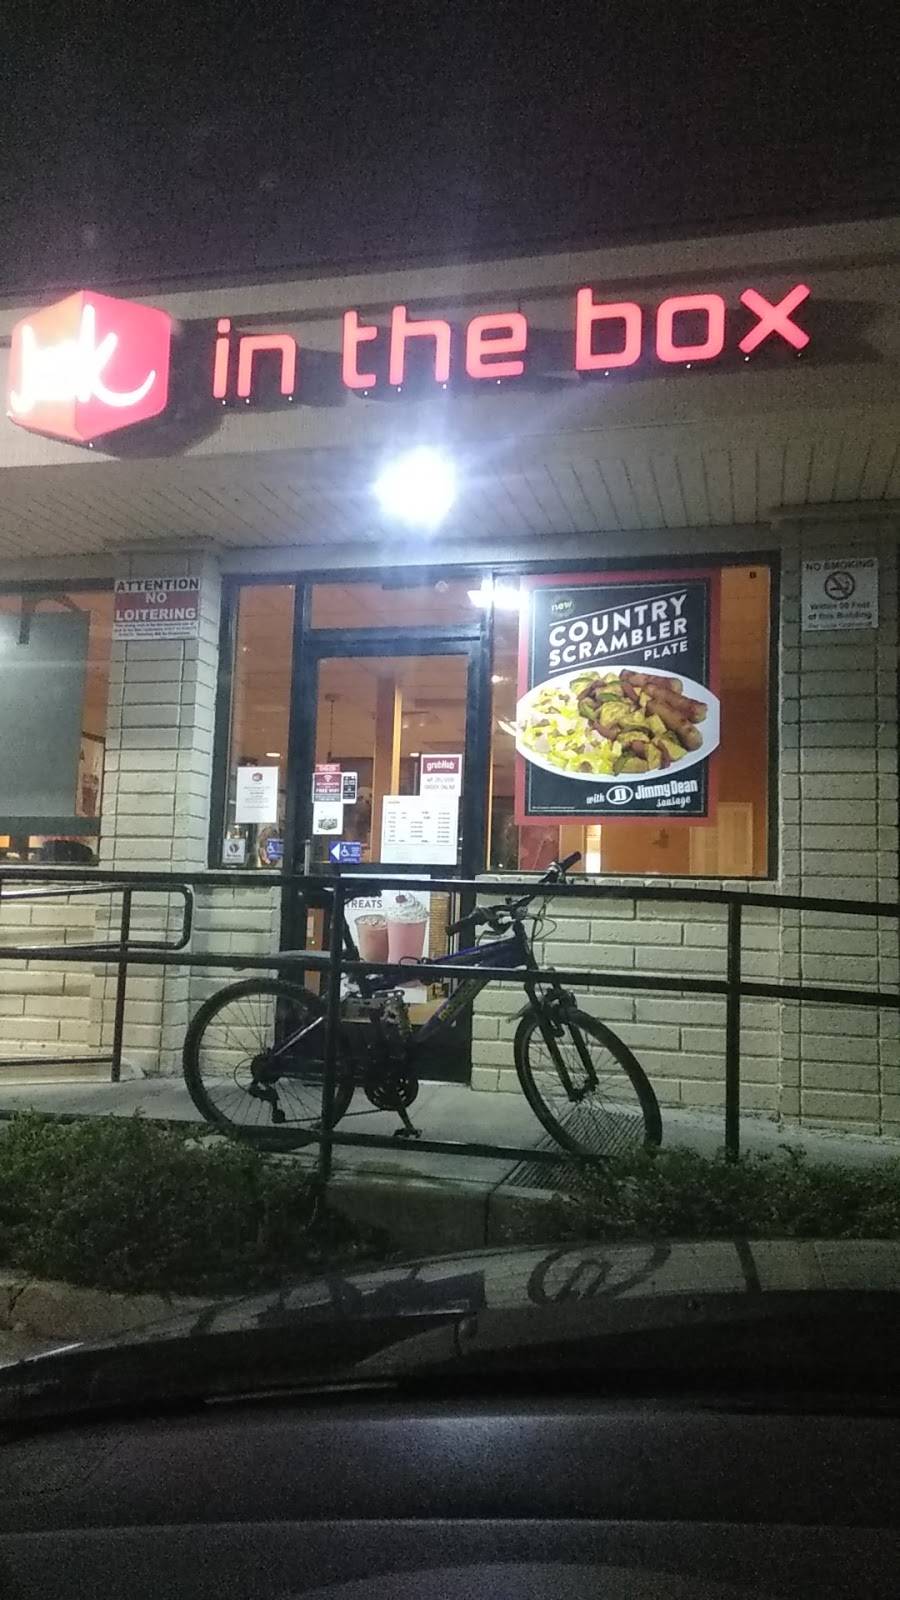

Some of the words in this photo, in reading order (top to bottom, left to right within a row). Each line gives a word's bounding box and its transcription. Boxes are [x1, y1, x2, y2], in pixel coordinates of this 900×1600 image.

[213, 318, 296, 398] in
[342, 304, 527, 389] the
[575, 284, 811, 371] box
[116, 579, 199, 592] ATTENTION
[145, 592, 167, 604] NO
[551, 600, 573, 611] new
[116, 607, 197, 621] LOITERING
[549, 594, 688, 647] COUNTRY
[549, 617, 688, 667] SCRAMBLER
[643, 640, 688, 661] PLATE
[586, 793, 605, 805] with
[635, 784, 671, 800] Jimmy
[670, 780, 698, 795] Dean
